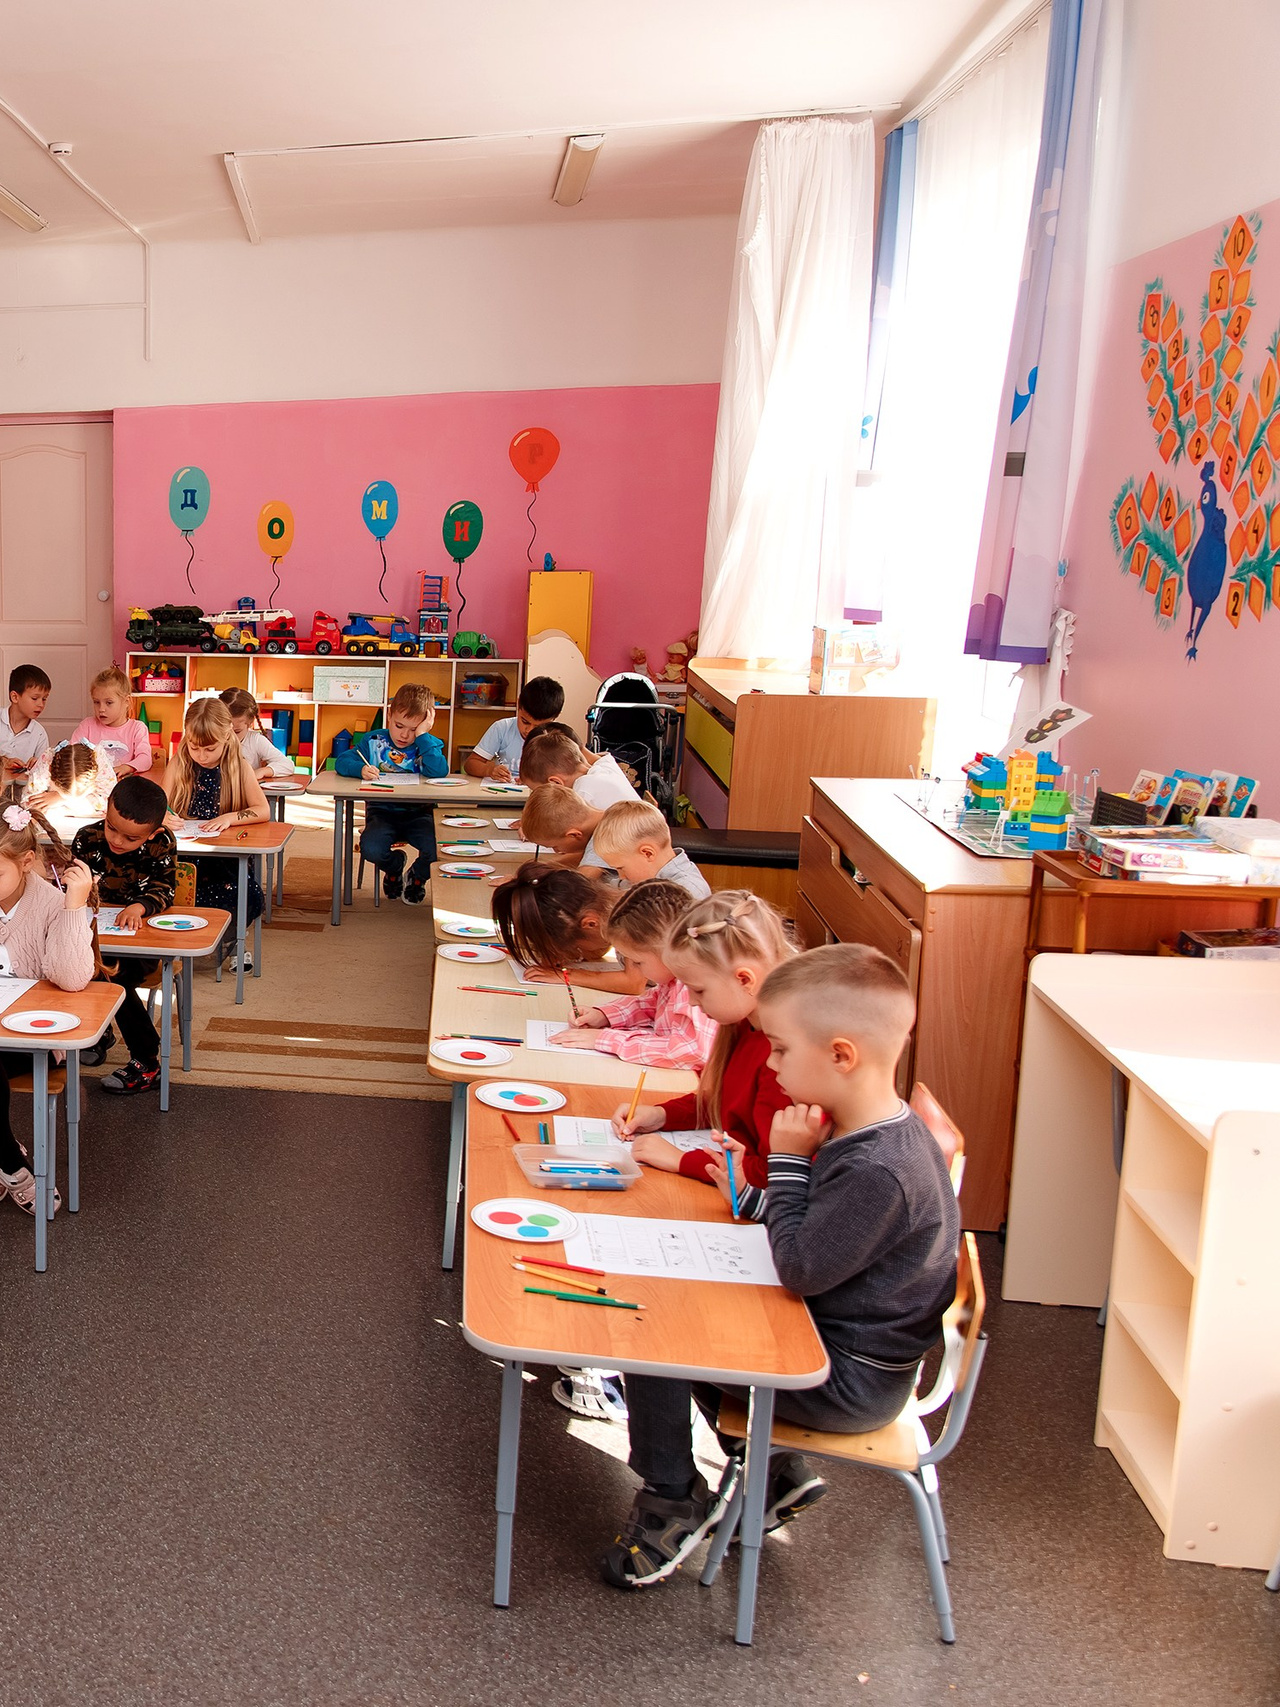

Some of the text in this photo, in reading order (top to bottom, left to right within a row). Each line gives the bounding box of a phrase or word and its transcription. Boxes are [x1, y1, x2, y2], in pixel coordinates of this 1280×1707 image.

[1232, 227, 1245, 259] 10
[1216, 275, 1225, 304] 5
[1149, 304, 1159, 328] 8
[1233, 315, 1242, 338] 3
[1172, 339, 1180, 361] 3
[1225, 390, 1233, 415] 4
[1194, 437, 1202, 460] 2
[1224, 456, 1233, 476] 5
[1258, 458, 1265, 482] 4
[181, 488, 198, 510] Д
[371, 500, 388, 520] М
[1164, 497, 1172, 522] 2
[267, 517, 285, 539] О
[1124, 507, 1133, 530] 6
[454, 521, 470, 541] И
[1252, 517, 1260, 544] 4
[1164, 588, 1171, 609] 3
[1231, 591, 1240, 616] 2
